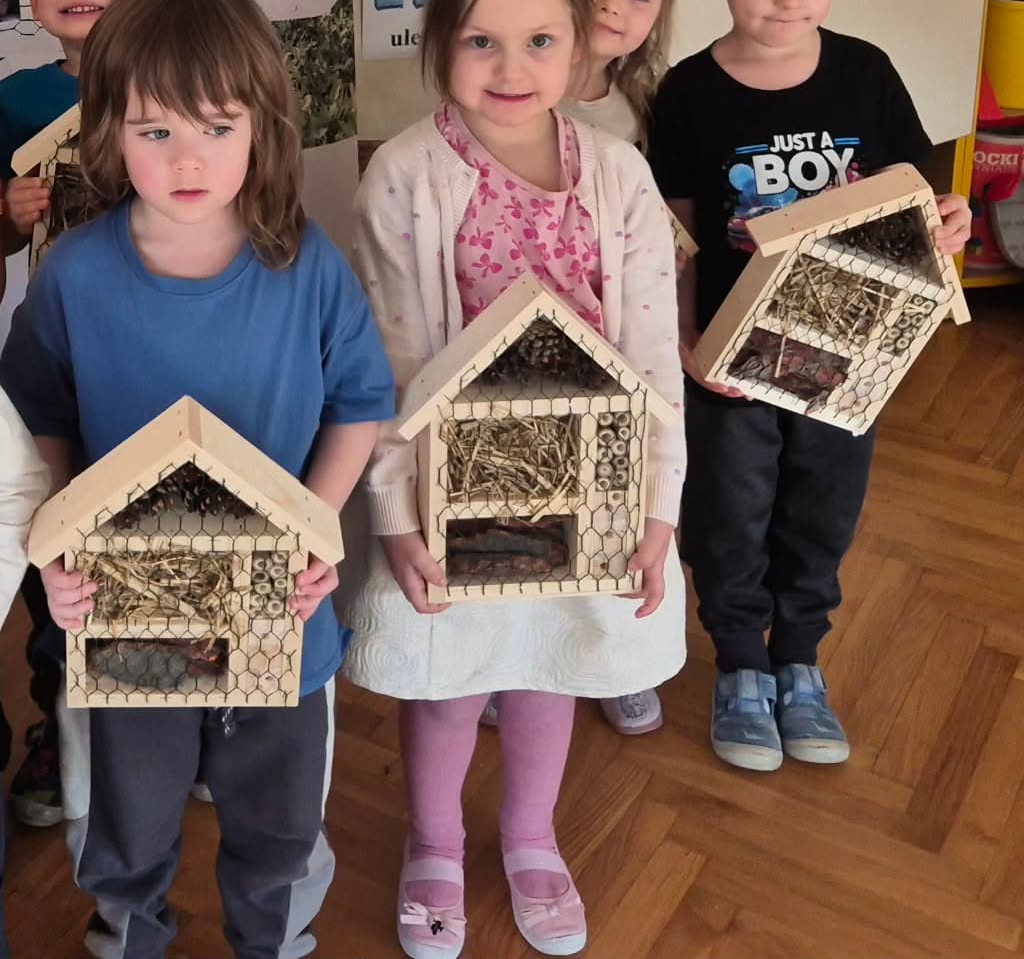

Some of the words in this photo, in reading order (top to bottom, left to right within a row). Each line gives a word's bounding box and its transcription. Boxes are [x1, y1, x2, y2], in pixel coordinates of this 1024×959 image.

[390, 28, 421, 47] ule
[770, 132, 816, 154] JUST
[821, 130, 835, 149] A
[752, 148, 855, 196] BOY
